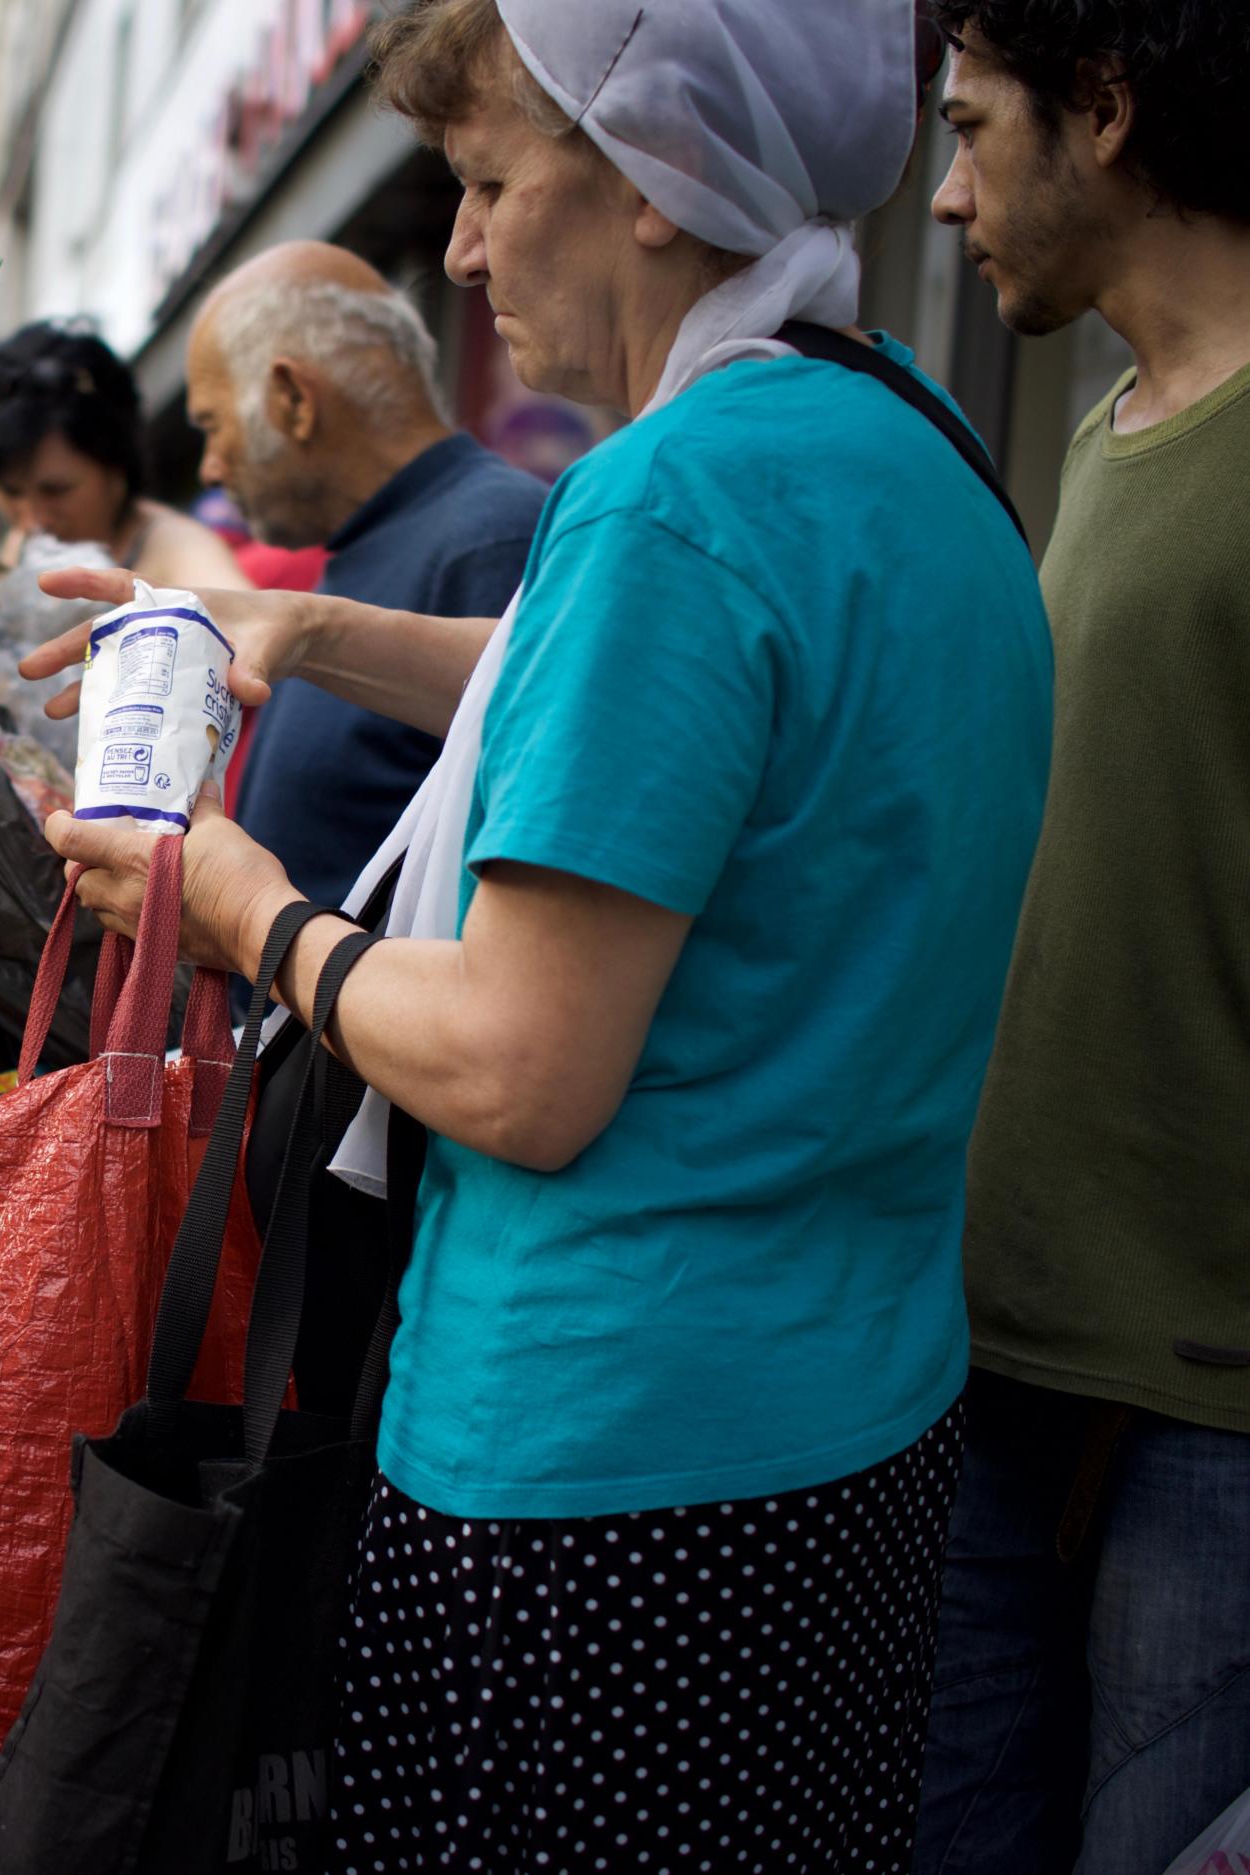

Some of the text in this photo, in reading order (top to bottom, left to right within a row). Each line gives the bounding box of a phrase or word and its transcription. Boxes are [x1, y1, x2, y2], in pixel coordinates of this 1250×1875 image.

[106, 747, 133, 755] PENSEZ
[106, 753, 116, 761] AU
[225, 1748, 327, 1863] BRN
